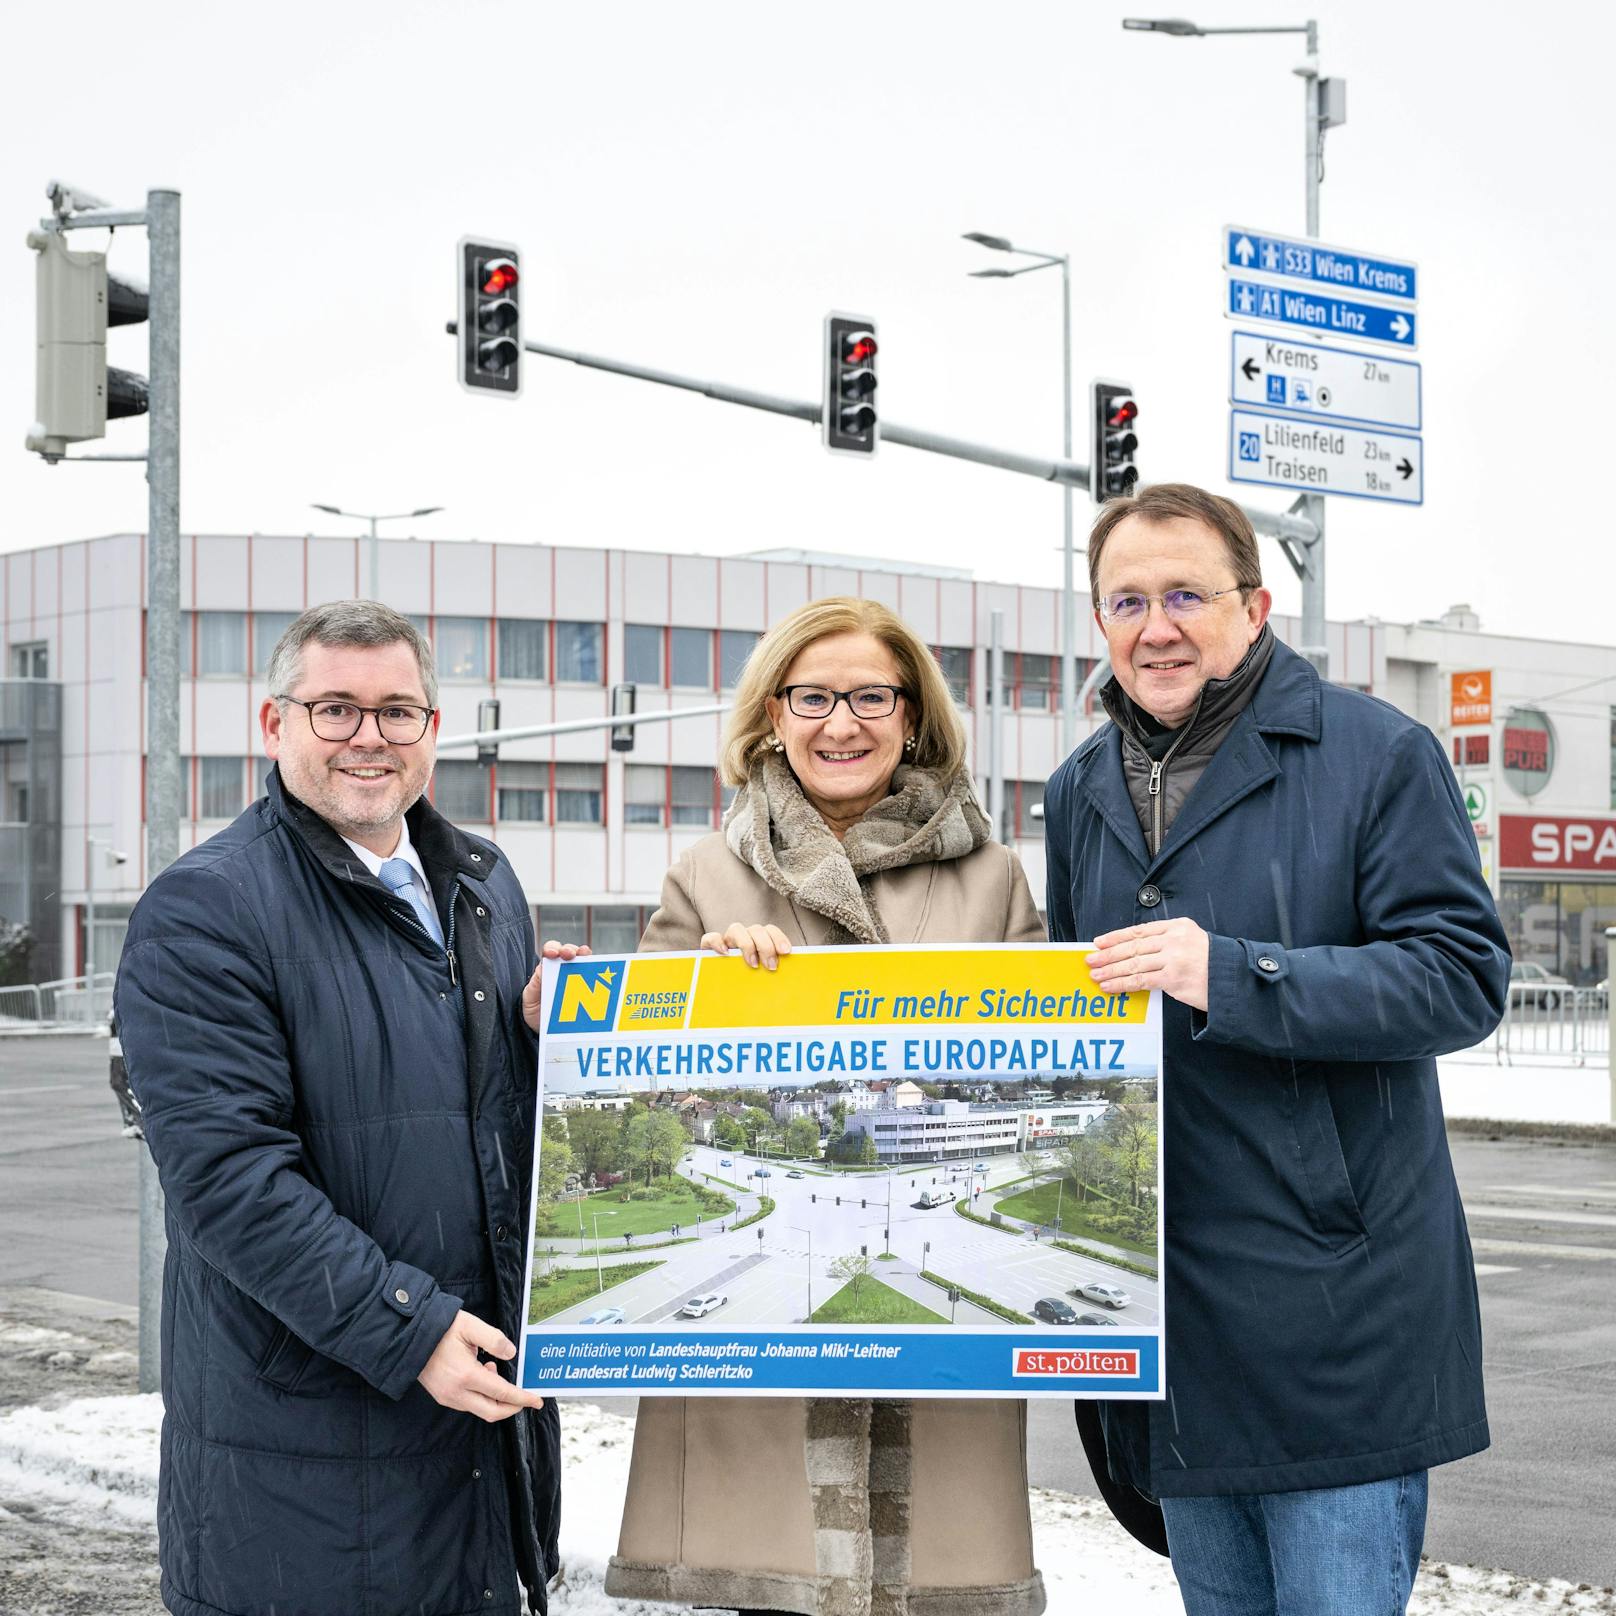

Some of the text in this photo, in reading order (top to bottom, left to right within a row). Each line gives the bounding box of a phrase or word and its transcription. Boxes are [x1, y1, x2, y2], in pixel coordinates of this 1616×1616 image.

[1284, 247, 1408, 293] S33 Wien Krems
[1261, 290, 1366, 332] A1 Wien Linz
[1265, 342, 1318, 371] Krems
[1240, 433, 1260, 460] 20
[1264, 423, 1345, 455] Lilienfeld
[1265, 455, 1328, 484] Traisen
[1505, 751, 1546, 770] PUR
[1531, 822, 1616, 864] SPA
[625, 991, 688, 1006] STRASSEN
[640, 1005, 685, 1020] DIENST
[835, 988, 1130, 1019] Für mehr Sicherheit
[577, 1039, 1125, 1077] VERKEHRSFREIGABE EUROPAPLATZ
[540, 1343, 901, 1360] eine Initiative von Landeshauptfrau Johanna Mikl-Leitner
[539, 1364, 754, 1383] und Landesrat Ludwig Schleritzko
